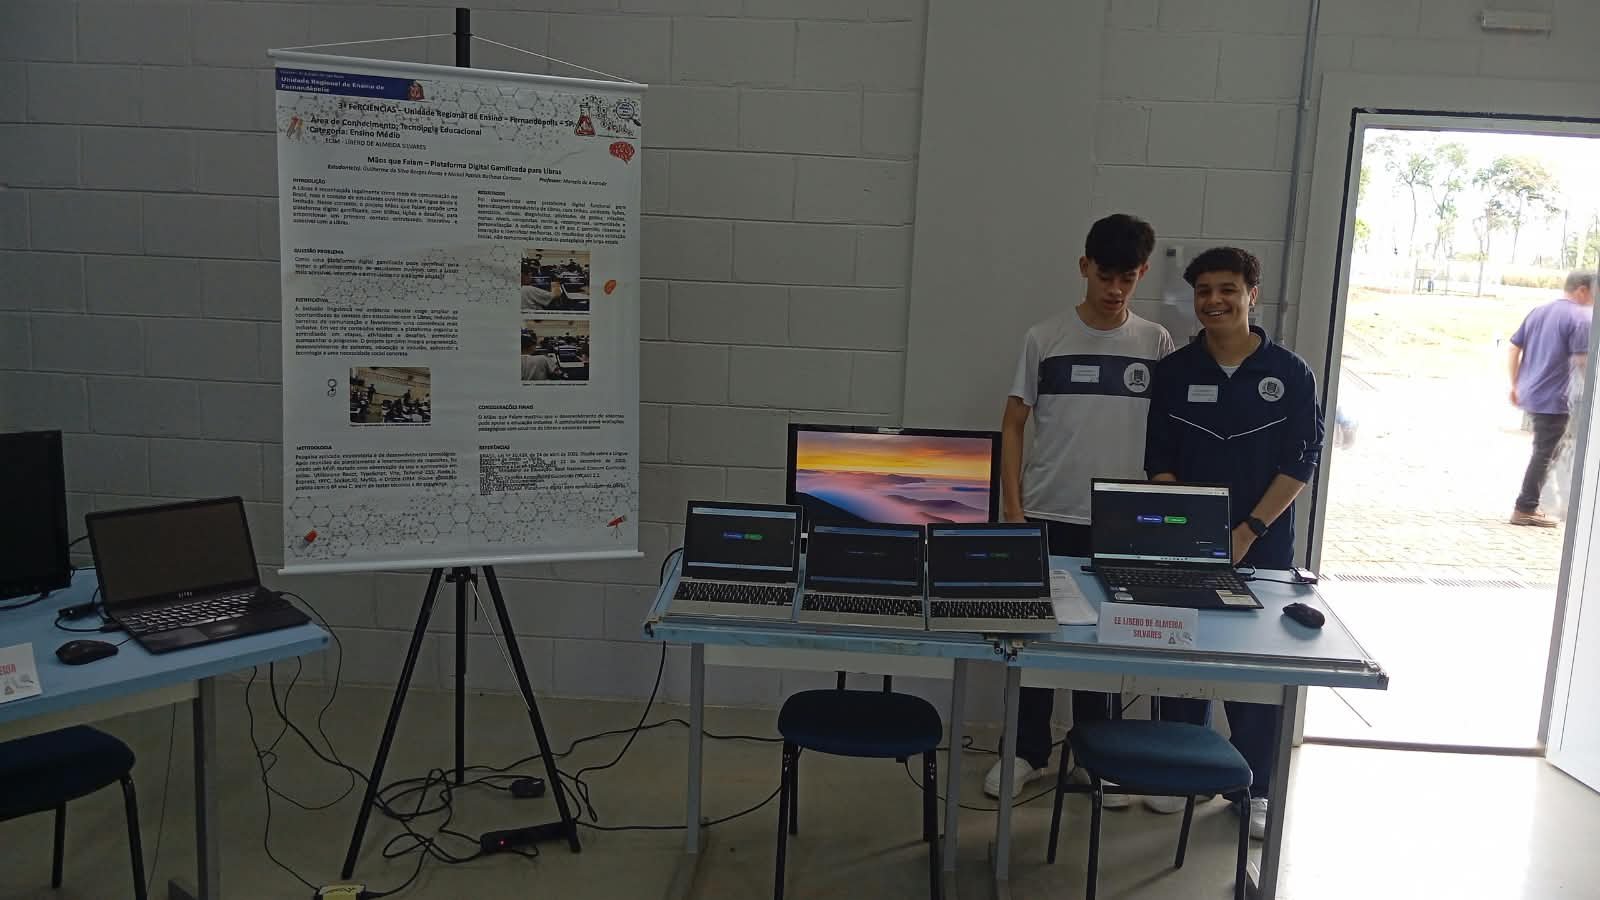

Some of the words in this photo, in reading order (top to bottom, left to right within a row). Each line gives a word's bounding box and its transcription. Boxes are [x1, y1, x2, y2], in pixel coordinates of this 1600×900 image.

[281, 76, 309, 84] Unidade
[311, 79, 341, 88] Regional
[404, 107, 434, 116] Unidade
[437, 110, 467, 120] Regional
[469, 112, 478, 120] de
[480, 113, 502, 122] Ensino
[510, 116, 558, 127] Fernandópolis
[309, 126, 348, 136] Categoria:
[350, 129, 374, 137] Ensino
[377, 130, 400, 139] Médio
[401, 123, 438, 134] Tecnologia
[441, 126, 481, 136] Educacional
[368, 156, 386, 164] Mãos
[389, 158, 401, 166] que
[403, 158, 423, 166] Falam
[430, 160, 466, 169] Plataforma
[469, 162, 489, 171] Digital
[490, 164, 526, 173] Gamificada
[528, 166, 542, 175] para
[544, 167, 561, 175] Libras
